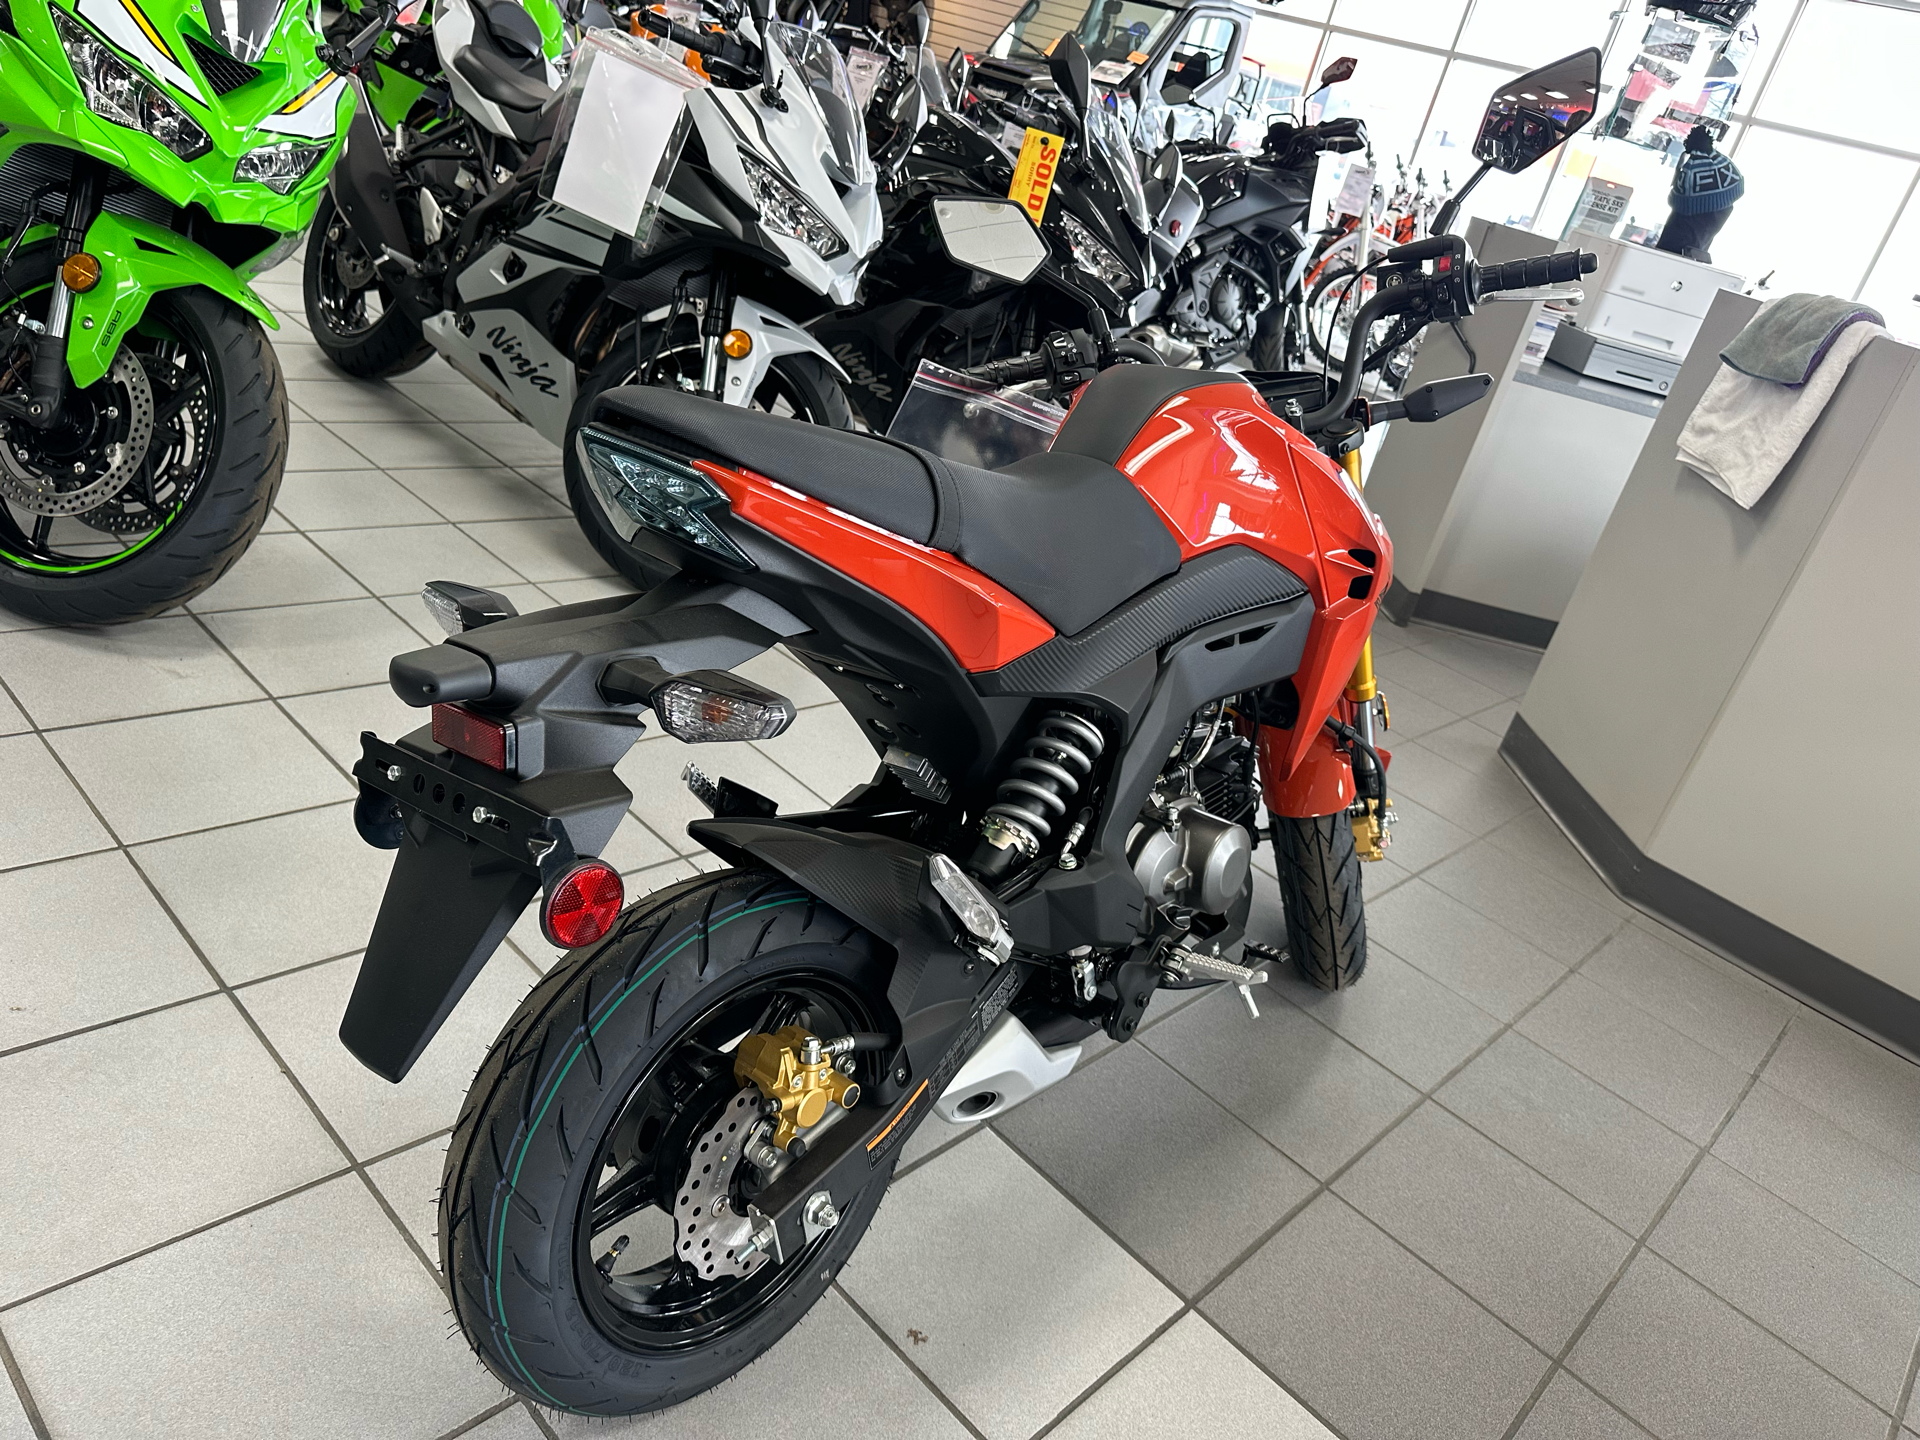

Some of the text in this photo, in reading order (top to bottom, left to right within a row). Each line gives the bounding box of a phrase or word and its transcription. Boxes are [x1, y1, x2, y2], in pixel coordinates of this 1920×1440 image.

[1025, 161, 1037, 188] SORRY
[1027, 145, 1057, 212] SOLD
[101, 309, 122, 348] ABS
[486, 325, 560, 399] Ninja
[831, 343, 893, 403] Ninja
